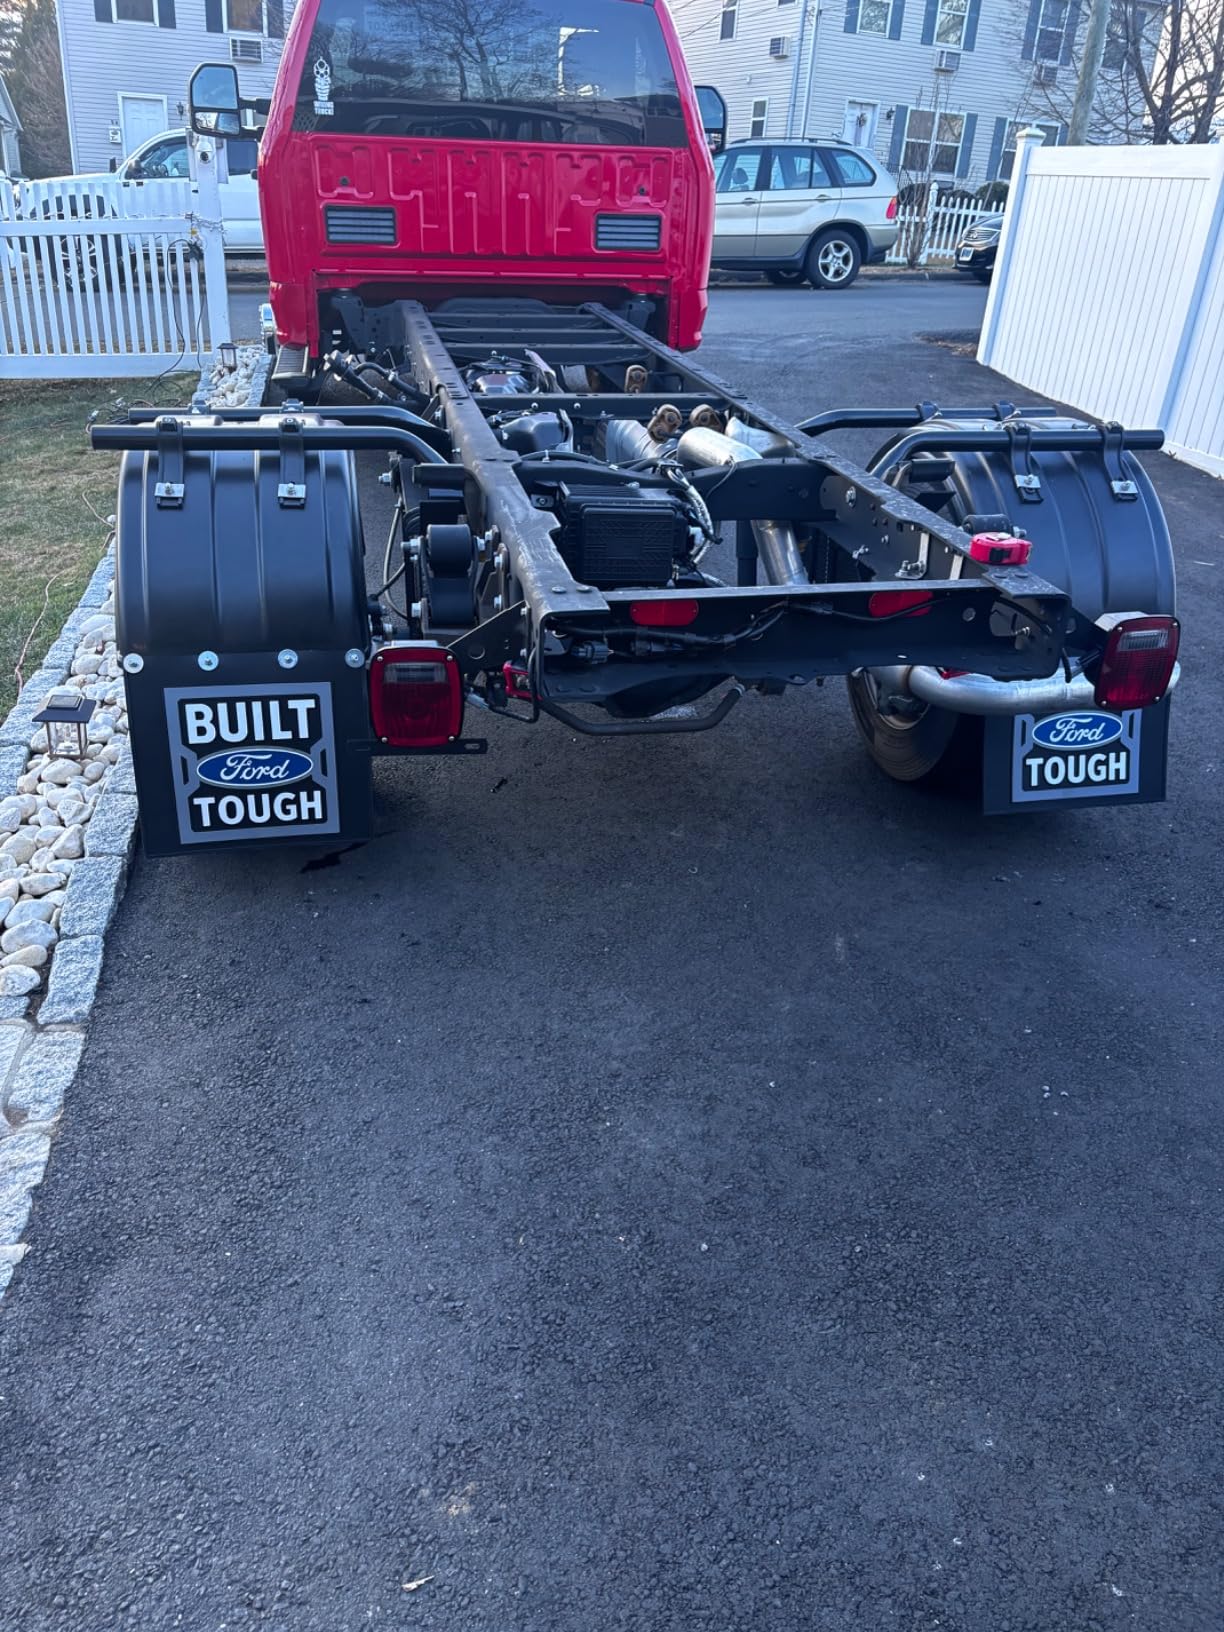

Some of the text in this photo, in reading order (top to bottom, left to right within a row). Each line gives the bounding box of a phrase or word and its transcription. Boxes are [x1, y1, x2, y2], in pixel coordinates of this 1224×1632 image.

[184, 699, 316, 744] BUILT
[1049, 717, 1106, 742] Ford
[219, 753, 291, 780] Ford
[1025, 751, 1127, 787] TOUGH
[193, 790, 323, 827] TOUGH
